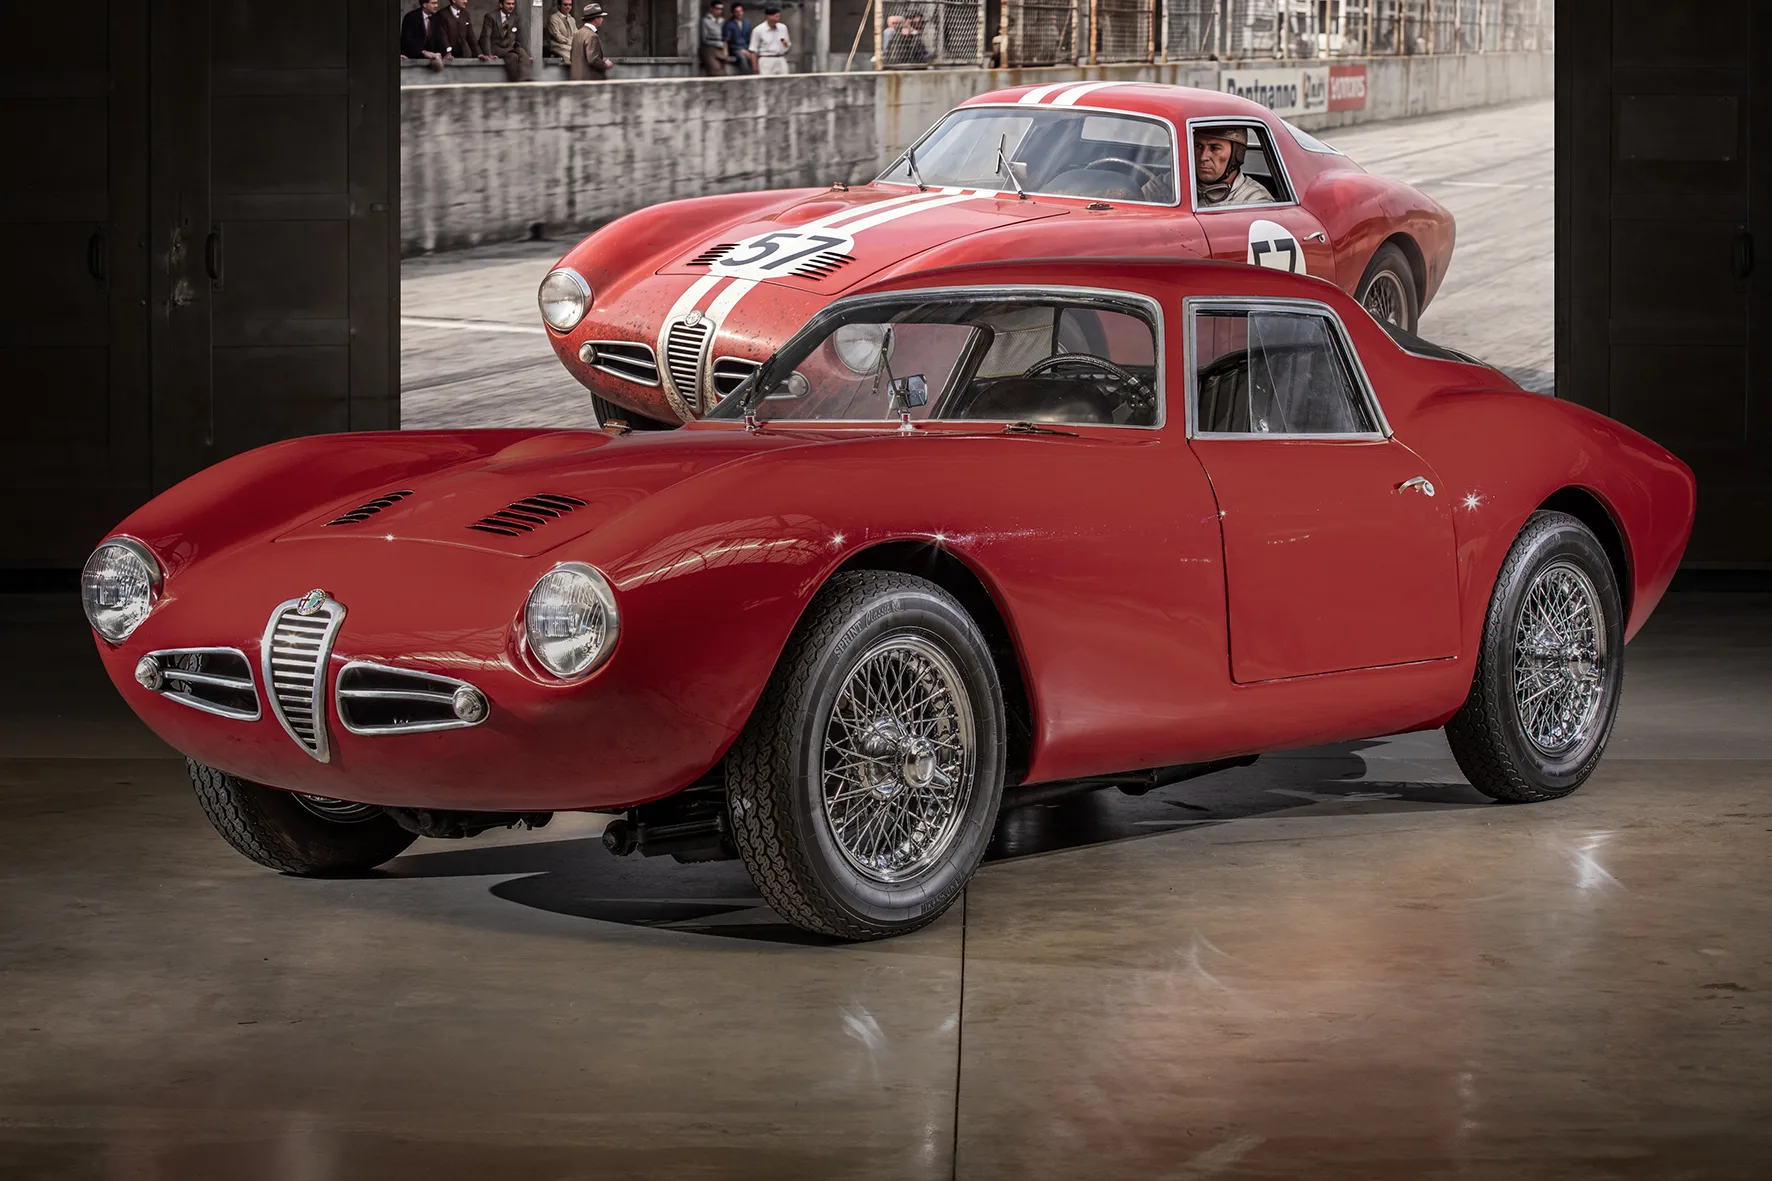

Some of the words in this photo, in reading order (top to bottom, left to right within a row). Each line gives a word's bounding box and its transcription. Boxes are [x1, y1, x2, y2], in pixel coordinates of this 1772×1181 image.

[719, 233, 848, 271] 57
[833, 620, 862, 658] SPRINT
[864, 605, 890, 628] Classic
